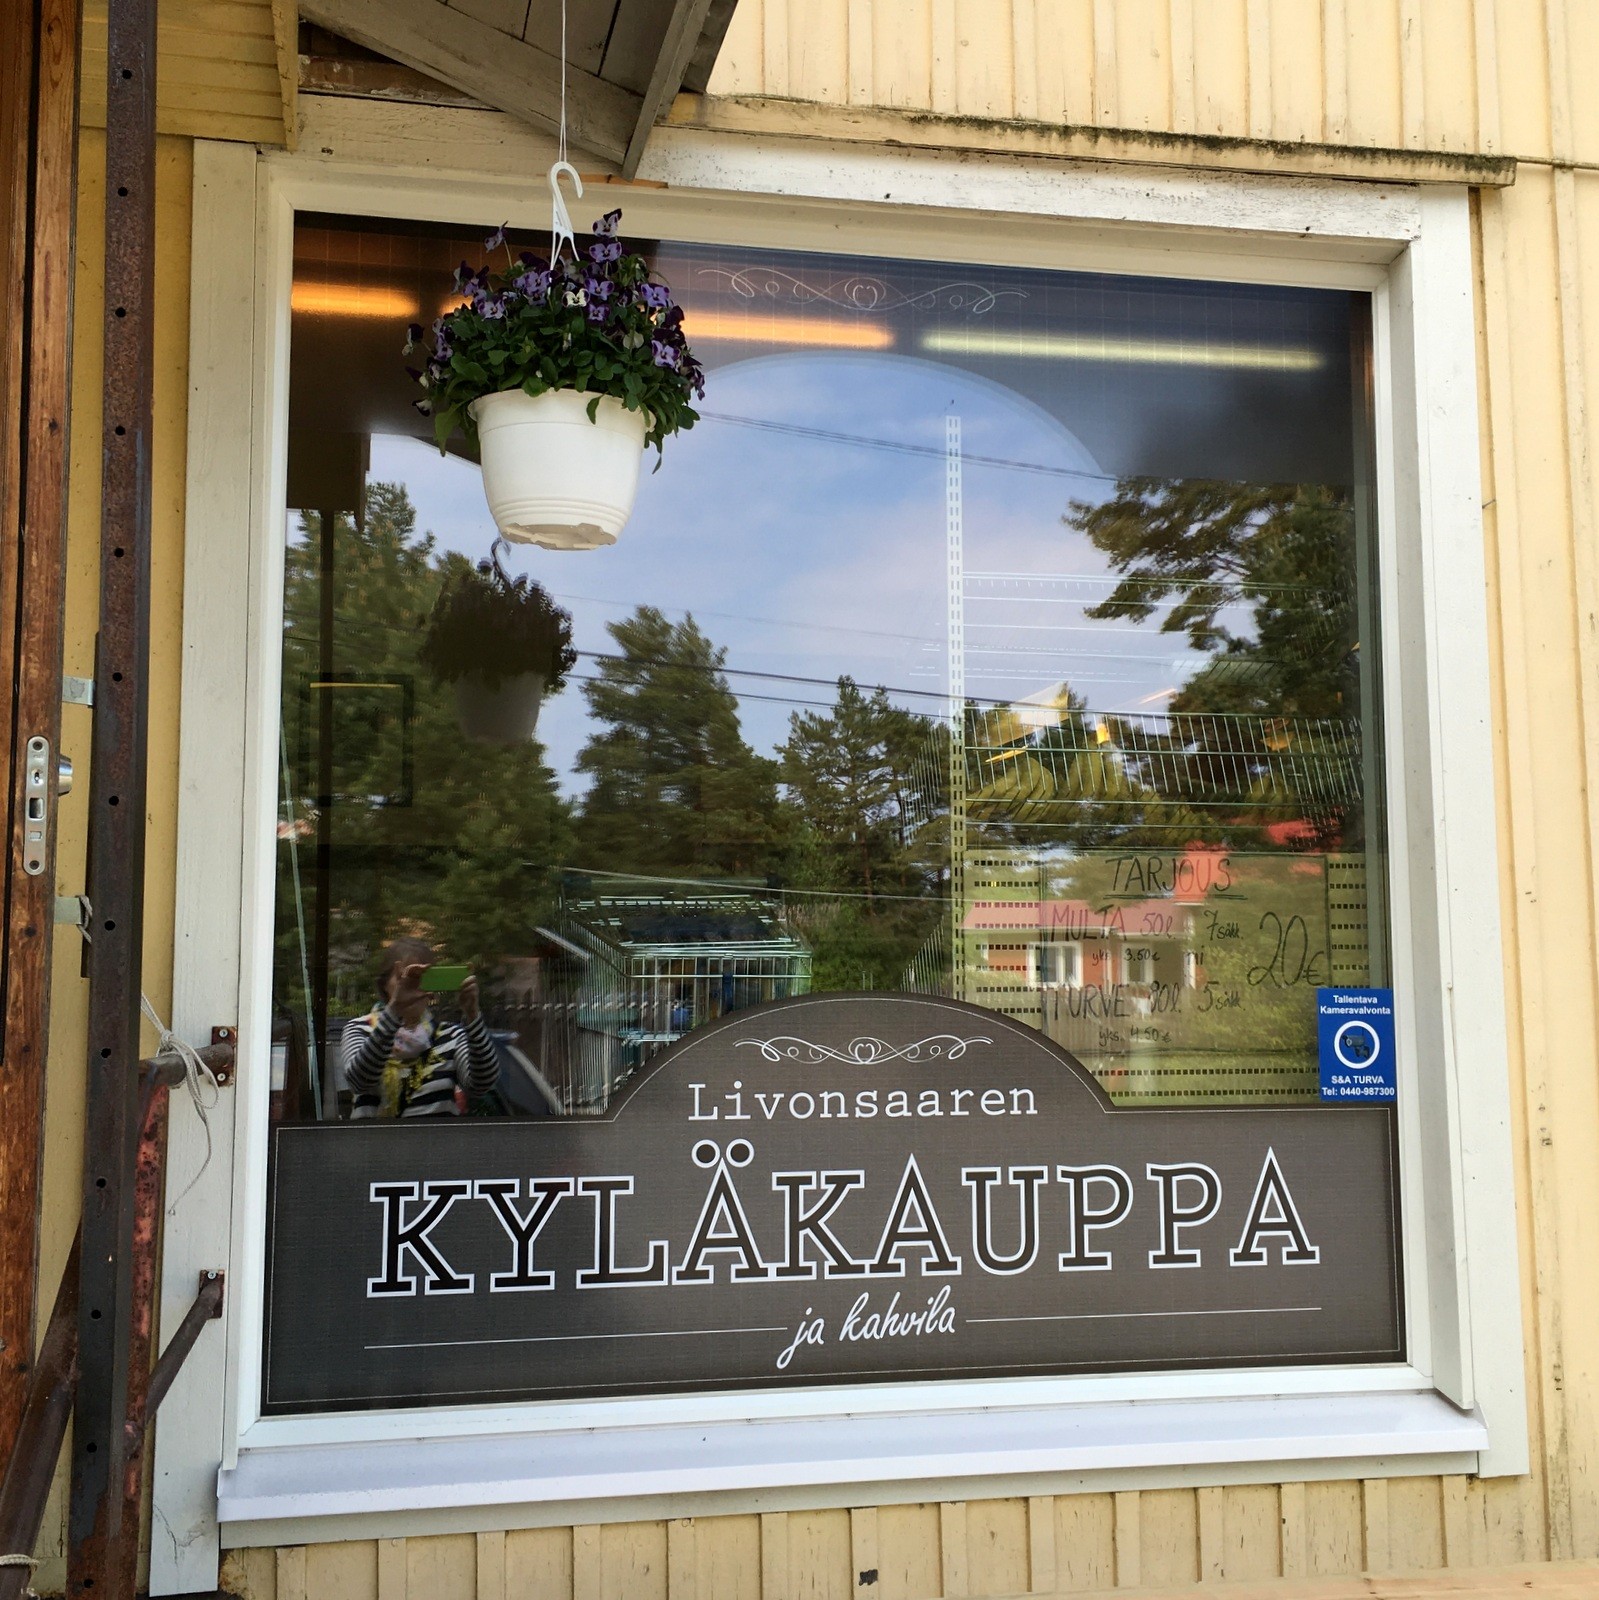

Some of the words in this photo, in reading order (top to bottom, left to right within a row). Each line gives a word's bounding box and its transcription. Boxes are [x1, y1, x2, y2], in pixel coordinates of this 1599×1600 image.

[1105, 855, 1231, 893] TARJOUS
[1050, 903, 1127, 942] MULTA
[1320, 1006, 1391, 1015] Kameravalvonta
[1333, 995, 1378, 1004] Tallentava
[1322, 1087, 1338, 1096] Tel:
[1340, 1088, 1395, 1096] 0440-987300
[1331, 1075, 1351, 1084] S&A
[1353, 1076, 1384, 1084] TURVA
[688, 1081, 1038, 1121] Livonsaaren
[365, 1138, 1321, 1299] KYLÄKAUPPA
[776, 1307, 825, 1369] ja
[839, 1284, 956, 1341] kahvila
